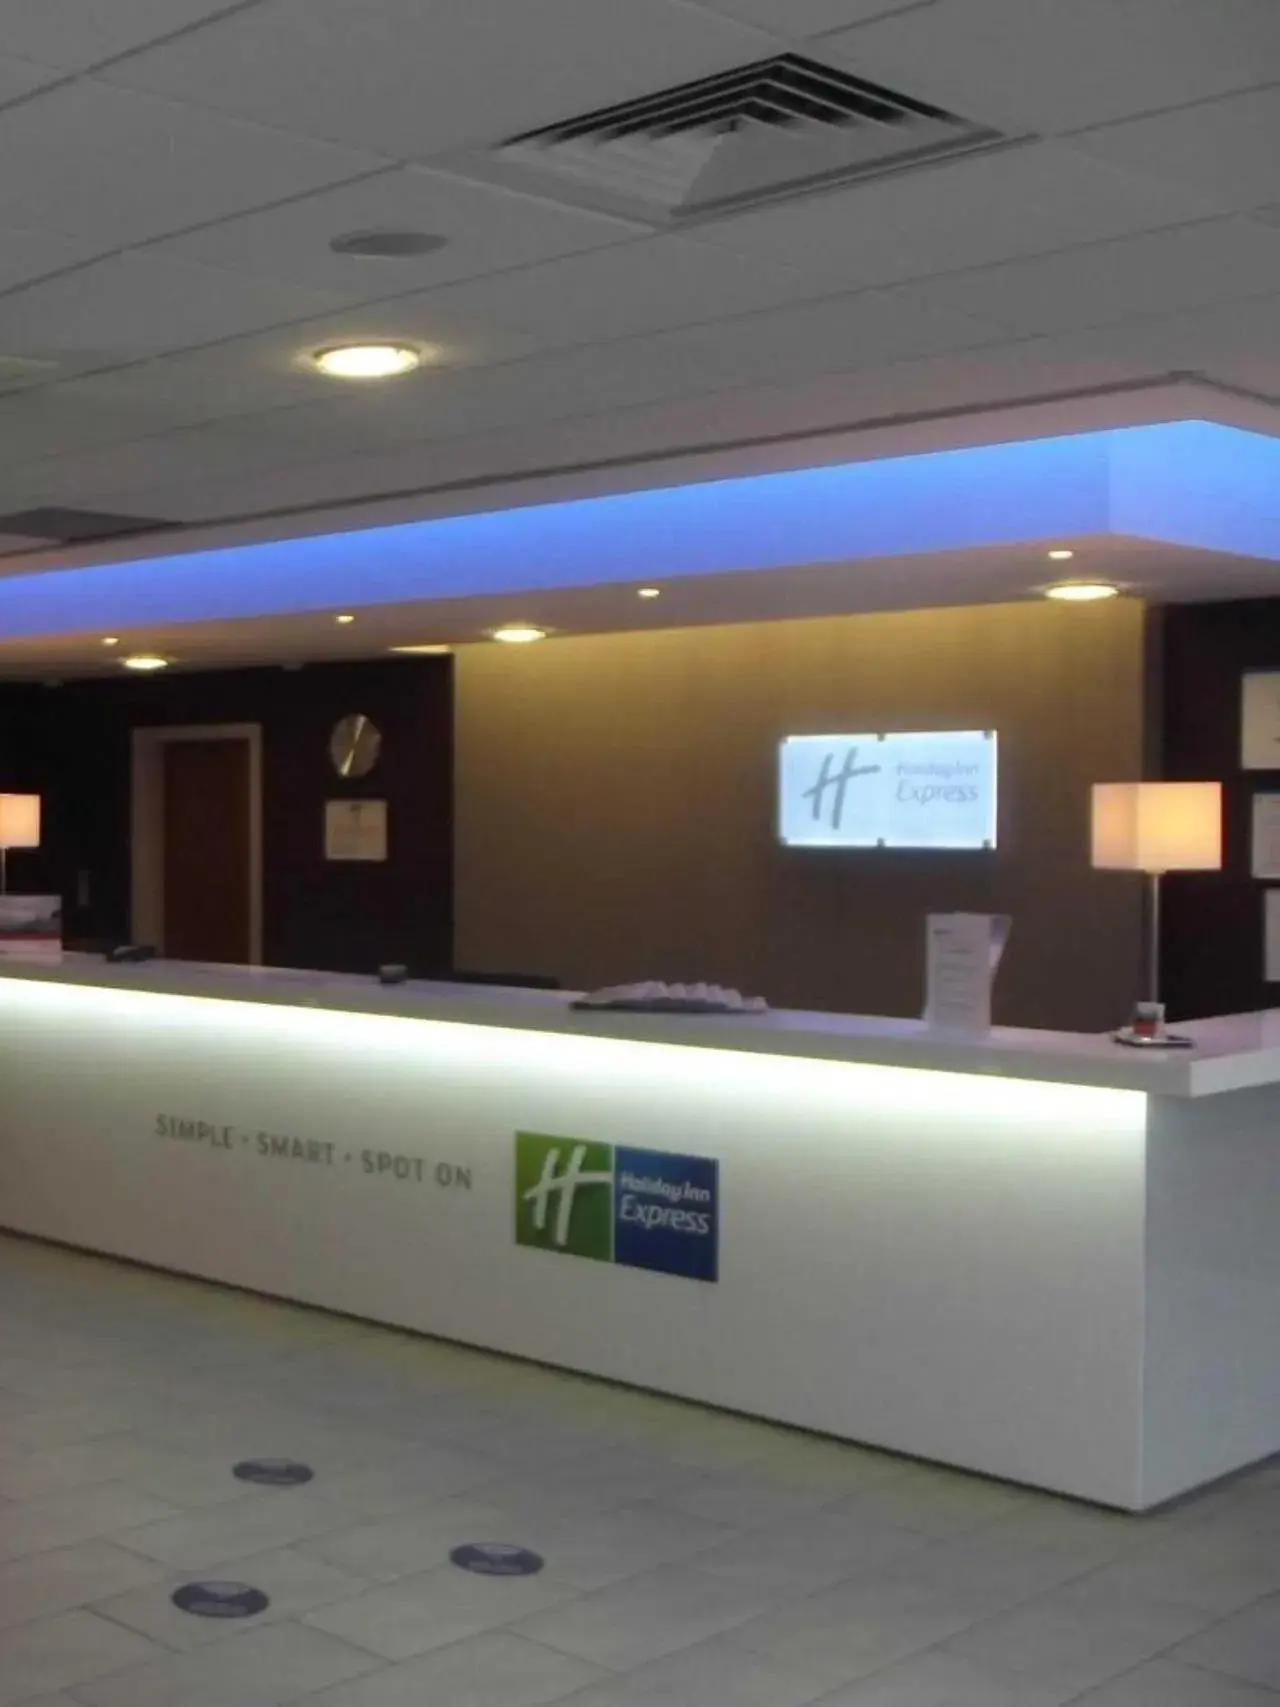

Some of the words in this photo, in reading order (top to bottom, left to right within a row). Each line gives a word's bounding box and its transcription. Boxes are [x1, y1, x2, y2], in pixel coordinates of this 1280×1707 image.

[895, 779, 979, 806] Express
[154, 1112, 234, 1150] SIMPLE
[256, 1131, 336, 1165] SMART
[361, 1149, 425, 1182] SPOT
[434, 1161, 473, 1190] ON
[683, 1180, 711, 1201] Inn
[620, 1193, 711, 1234] Express
